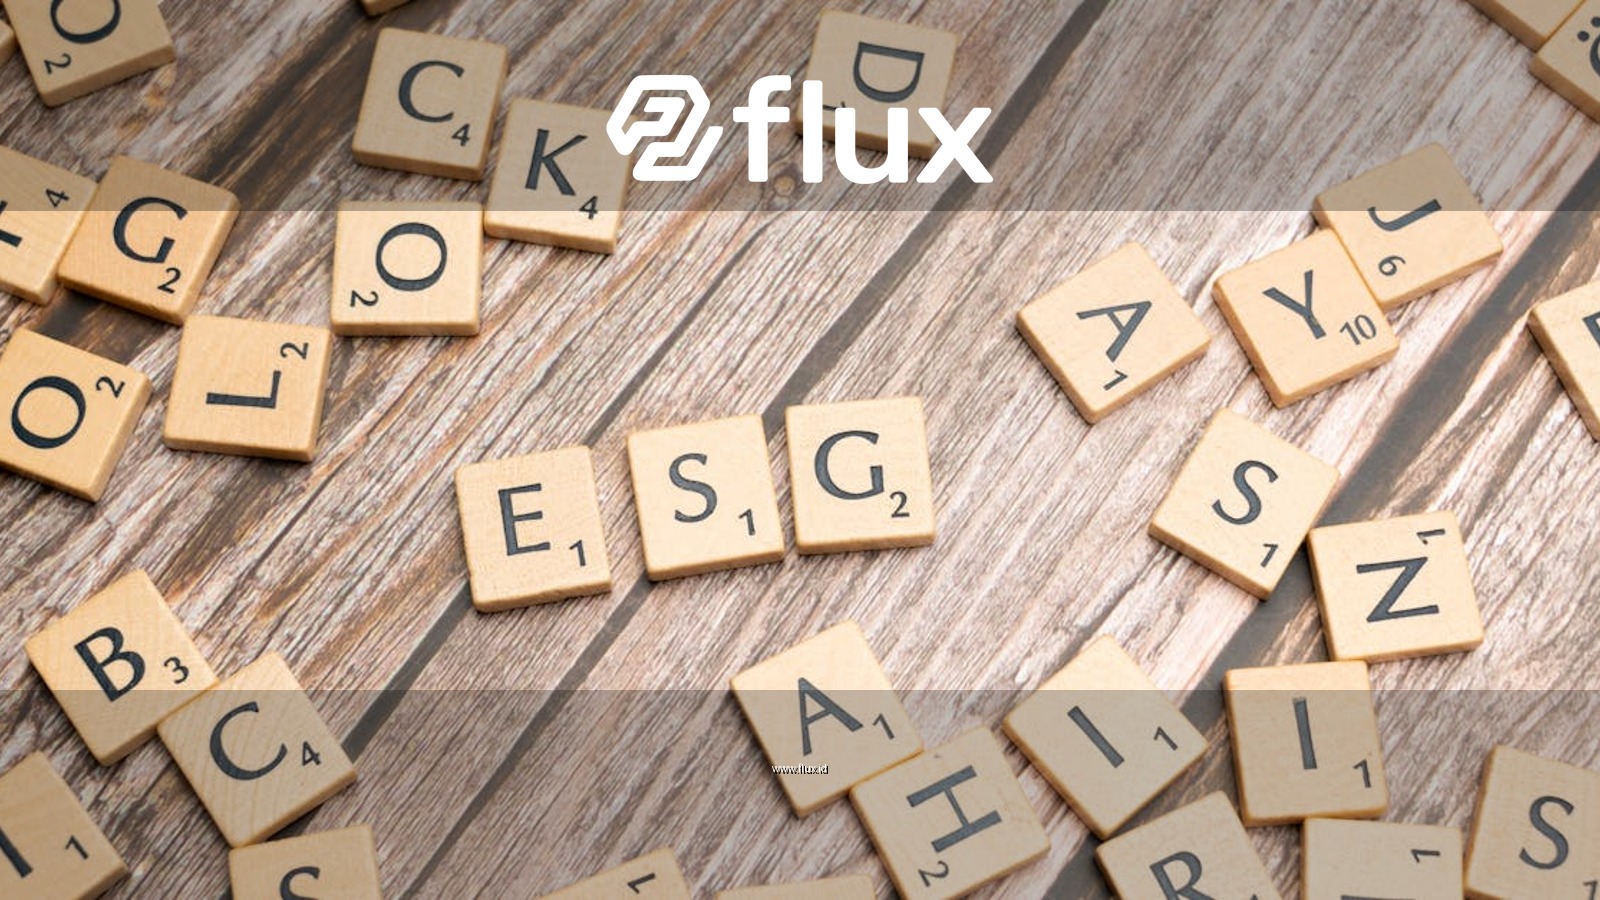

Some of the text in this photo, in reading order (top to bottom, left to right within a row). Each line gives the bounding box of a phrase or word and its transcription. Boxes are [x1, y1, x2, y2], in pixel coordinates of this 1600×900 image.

[44, 54, 71, 74] 2
[853, 42, 925, 103] D
[398, 61, 470, 146] C 4
[46, 189, 69, 207] 4
[525, 129, 598, 219] K 4
[113, 196, 187, 294] G 2
[1366, 198, 1443, 231] J
[350, 222, 447, 307] O 2
[1263, 270, 1376, 345] Y 10
[206, 343, 308, 409] L 2
[1076, 301, 1152, 390] A 1
[11, 376, 125, 449] O 2
[669, 453, 755, 535] S 1
[814, 430, 909, 518] G 2
[498, 483, 586, 566] E 1
[1212, 460, 1278, 567] S 1
[1417, 529, 1445, 544] 1
[74, 627, 189, 702] B 3
[210, 702, 321, 780] C 4
[799, 678, 894, 756] A 1
[1067, 706, 1178, 768] I 1
[1293, 698, 1371, 788] I 1
[65, 836, 88, 859] 1
[1411, 849, 1440, 862] 1
[1519, 796, 1574, 870] S
[628, 873, 655, 894] 1
[918, 861, 949, 887] 2
